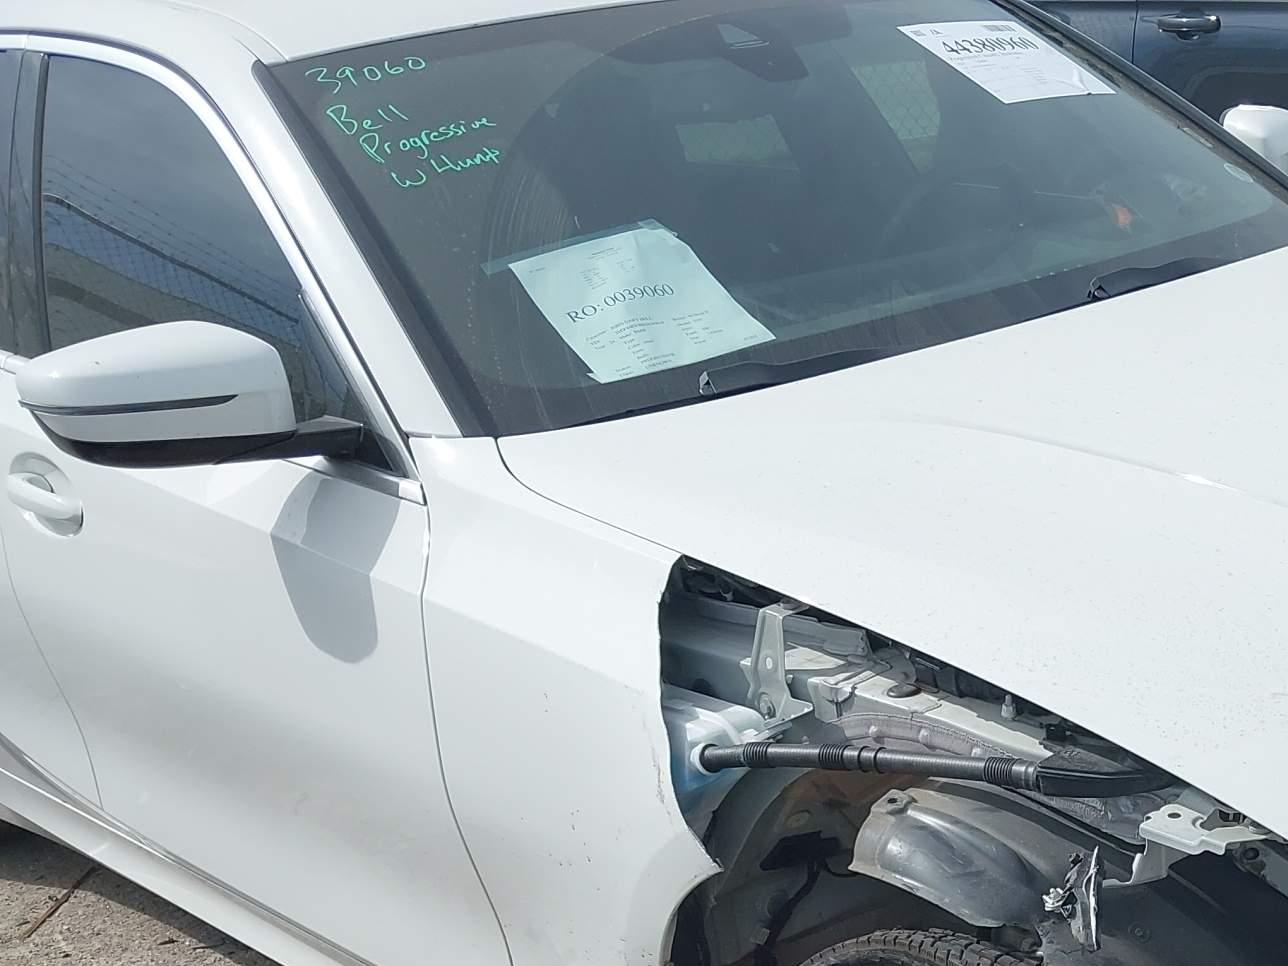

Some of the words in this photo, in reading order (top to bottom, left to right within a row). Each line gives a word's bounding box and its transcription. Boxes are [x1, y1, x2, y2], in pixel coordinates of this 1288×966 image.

[942, 36, 1040, 55] 44380960
[305, 56, 427, 94] 39060
[326, 104, 409, 135] Bell
[359, 116, 497, 164] Progressive
[603, 283, 674, 307] 0039060
